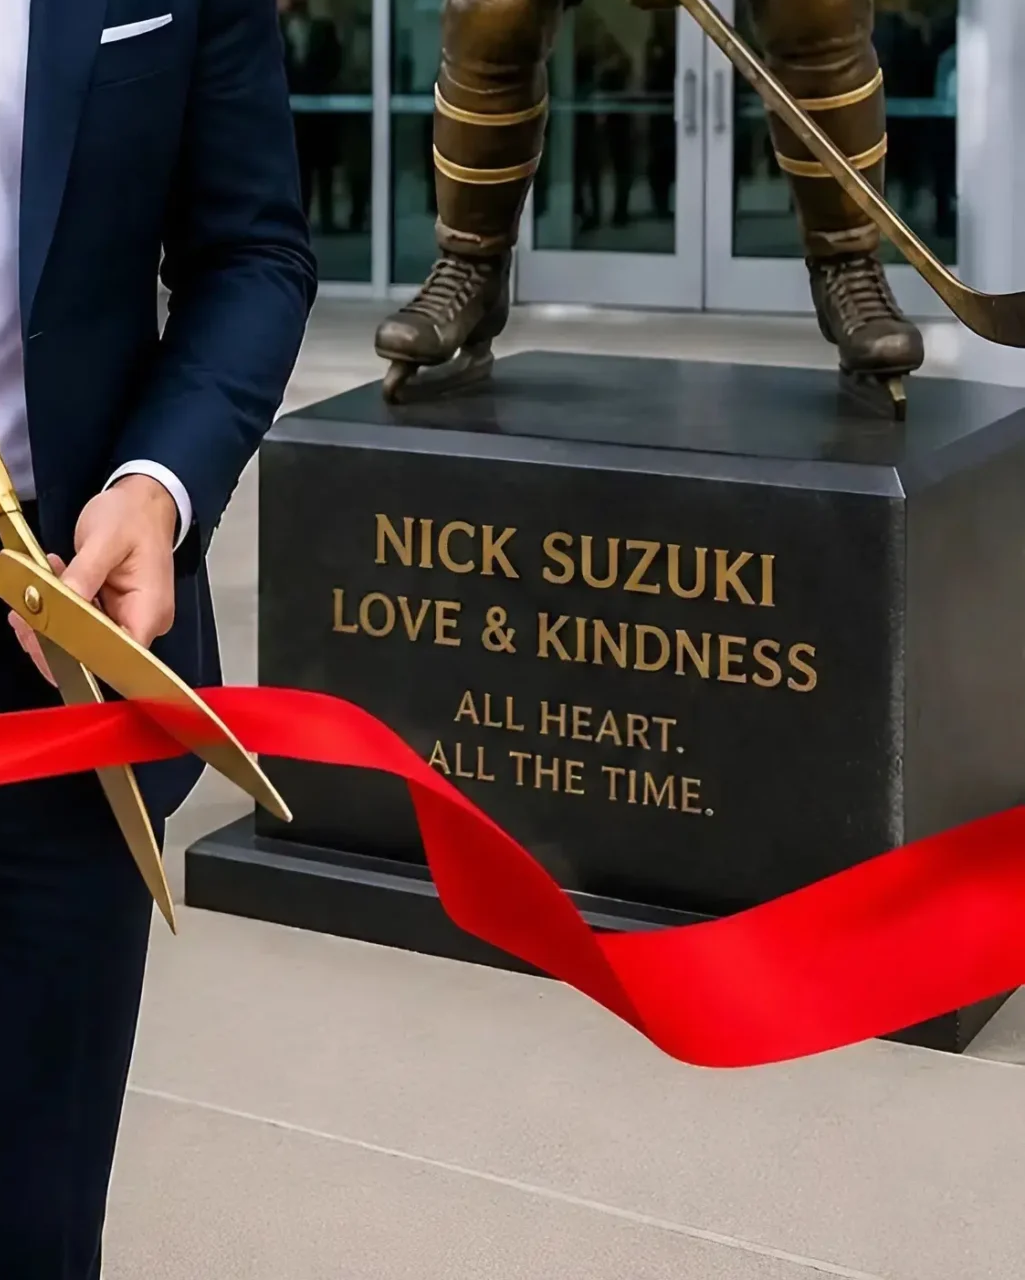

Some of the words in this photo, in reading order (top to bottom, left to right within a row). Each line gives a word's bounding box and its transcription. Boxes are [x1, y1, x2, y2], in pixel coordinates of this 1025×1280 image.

[374, 513, 519, 578] NICK
[541, 530, 776, 607] SUZUKI
[331, 588, 462, 646] LOVE
[480, 605, 517, 653] &
[536, 611, 818, 692] KINDNESS
[454, 690, 525, 732] ALL
[538, 699, 685, 755] HEART.
[427, 740, 496, 781] ALL
[508, 749, 585, 795] THE
[601, 765, 715, 818] TIME.
